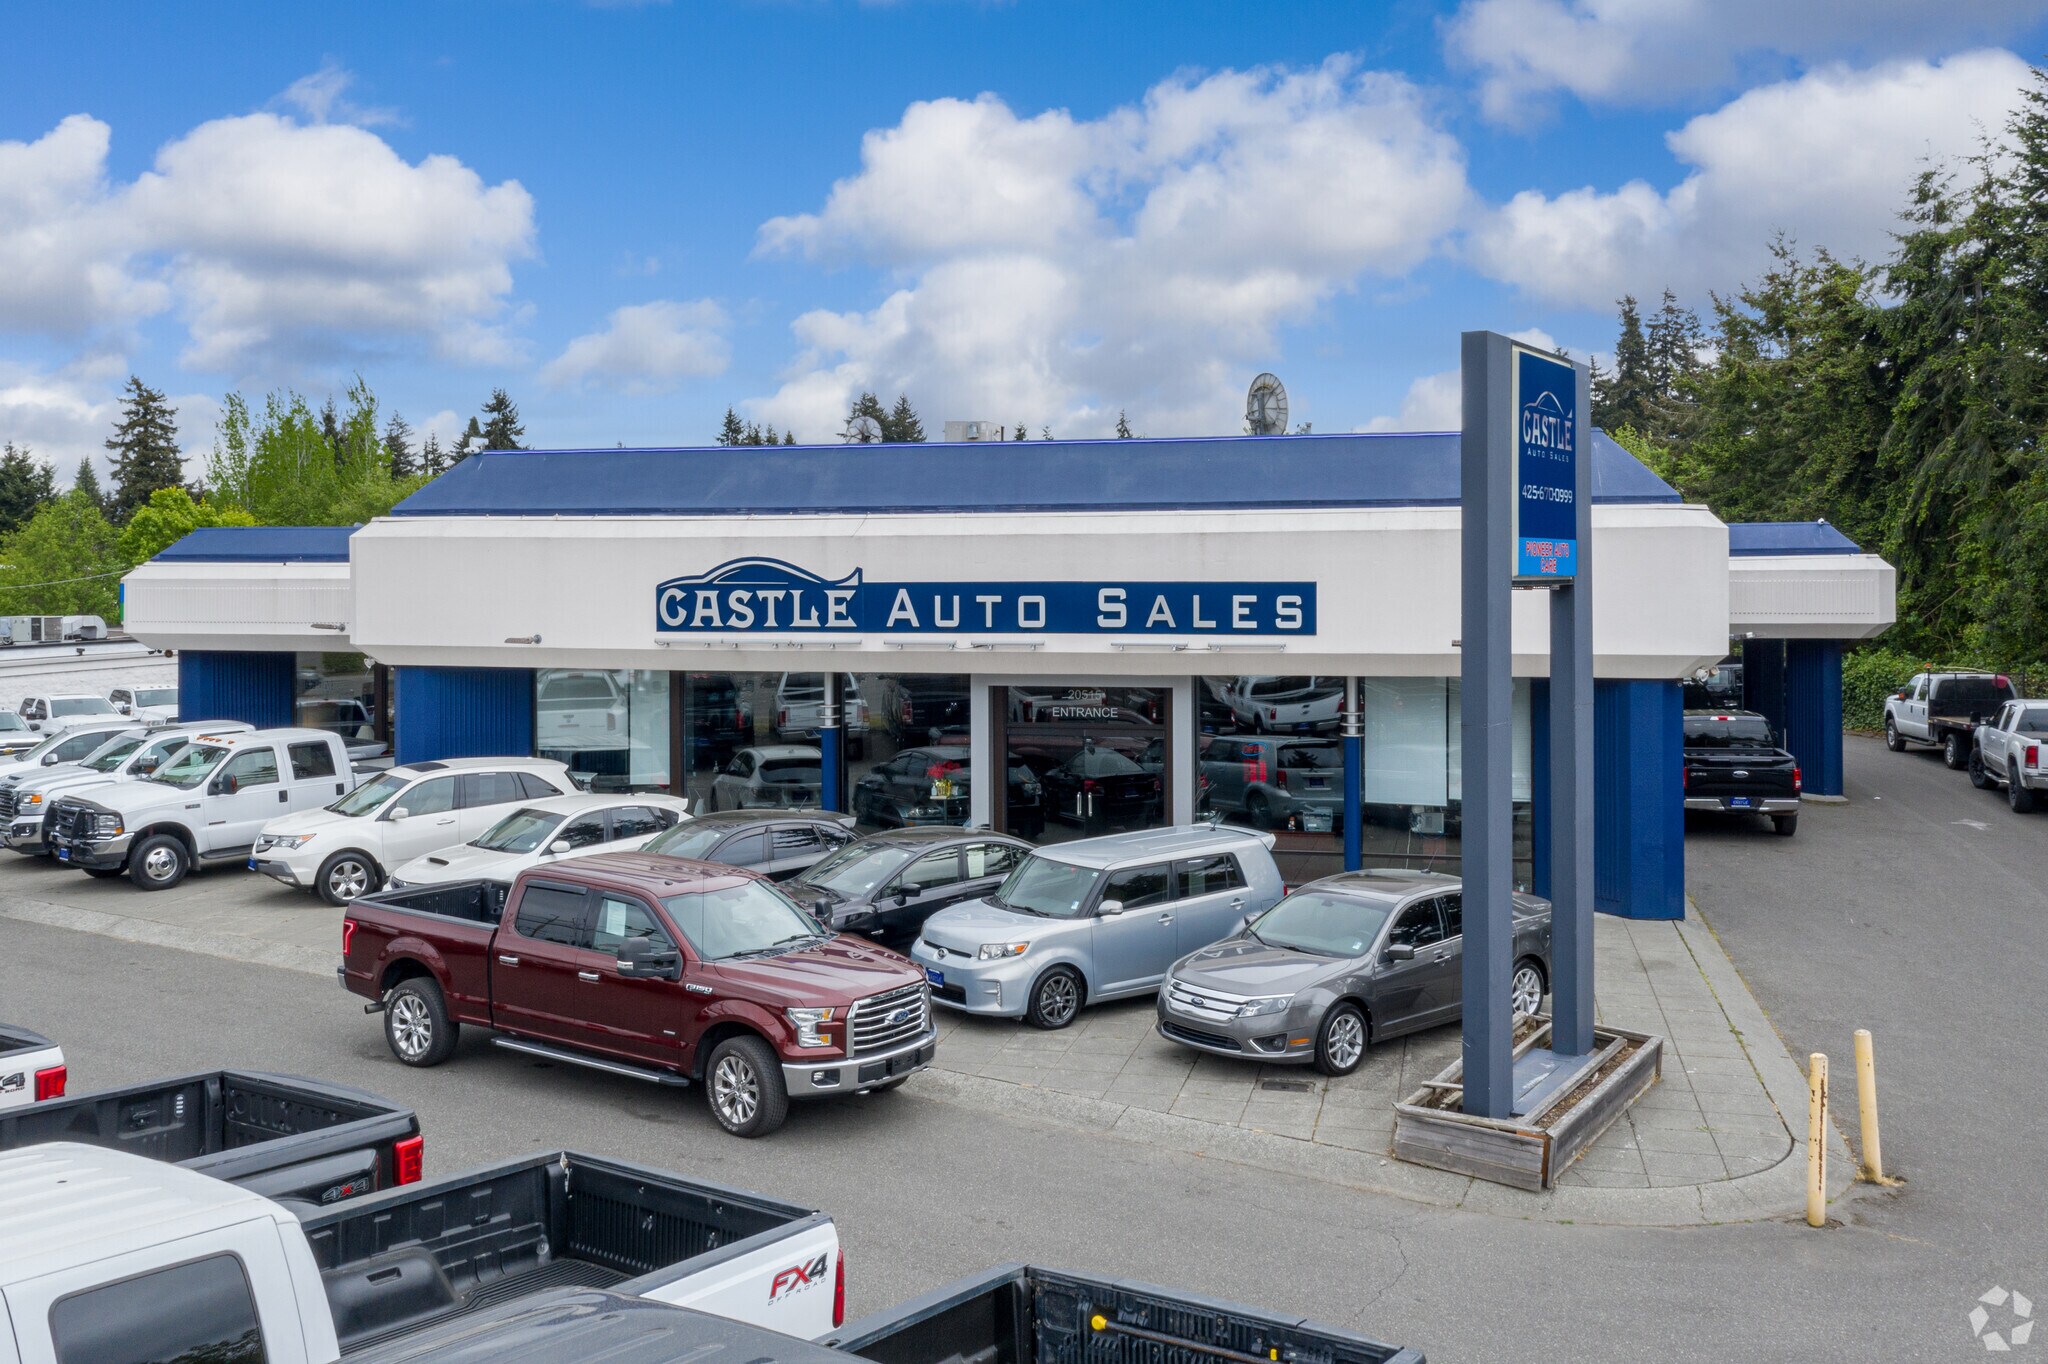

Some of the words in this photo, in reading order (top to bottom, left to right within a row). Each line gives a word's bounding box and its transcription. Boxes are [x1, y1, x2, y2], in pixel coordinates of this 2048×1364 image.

[1523, 410, 1572, 451] CASTLE
[1522, 484, 1573, 503] 425-670-0999
[1526, 541, 1552, 557] PIONEER
[1554, 542, 1570, 557] AUTO
[1540, 558, 1557, 573] CARE
[659, 588, 857, 629] CASTLE
[886, 588, 1046, 628] AUTO
[1097, 588, 1302, 629] SALES
[1068, 690, 1101, 700] 20515
[1052, 707, 1118, 718] ENTRANCE
[769, 1252, 828, 1300] FX4
